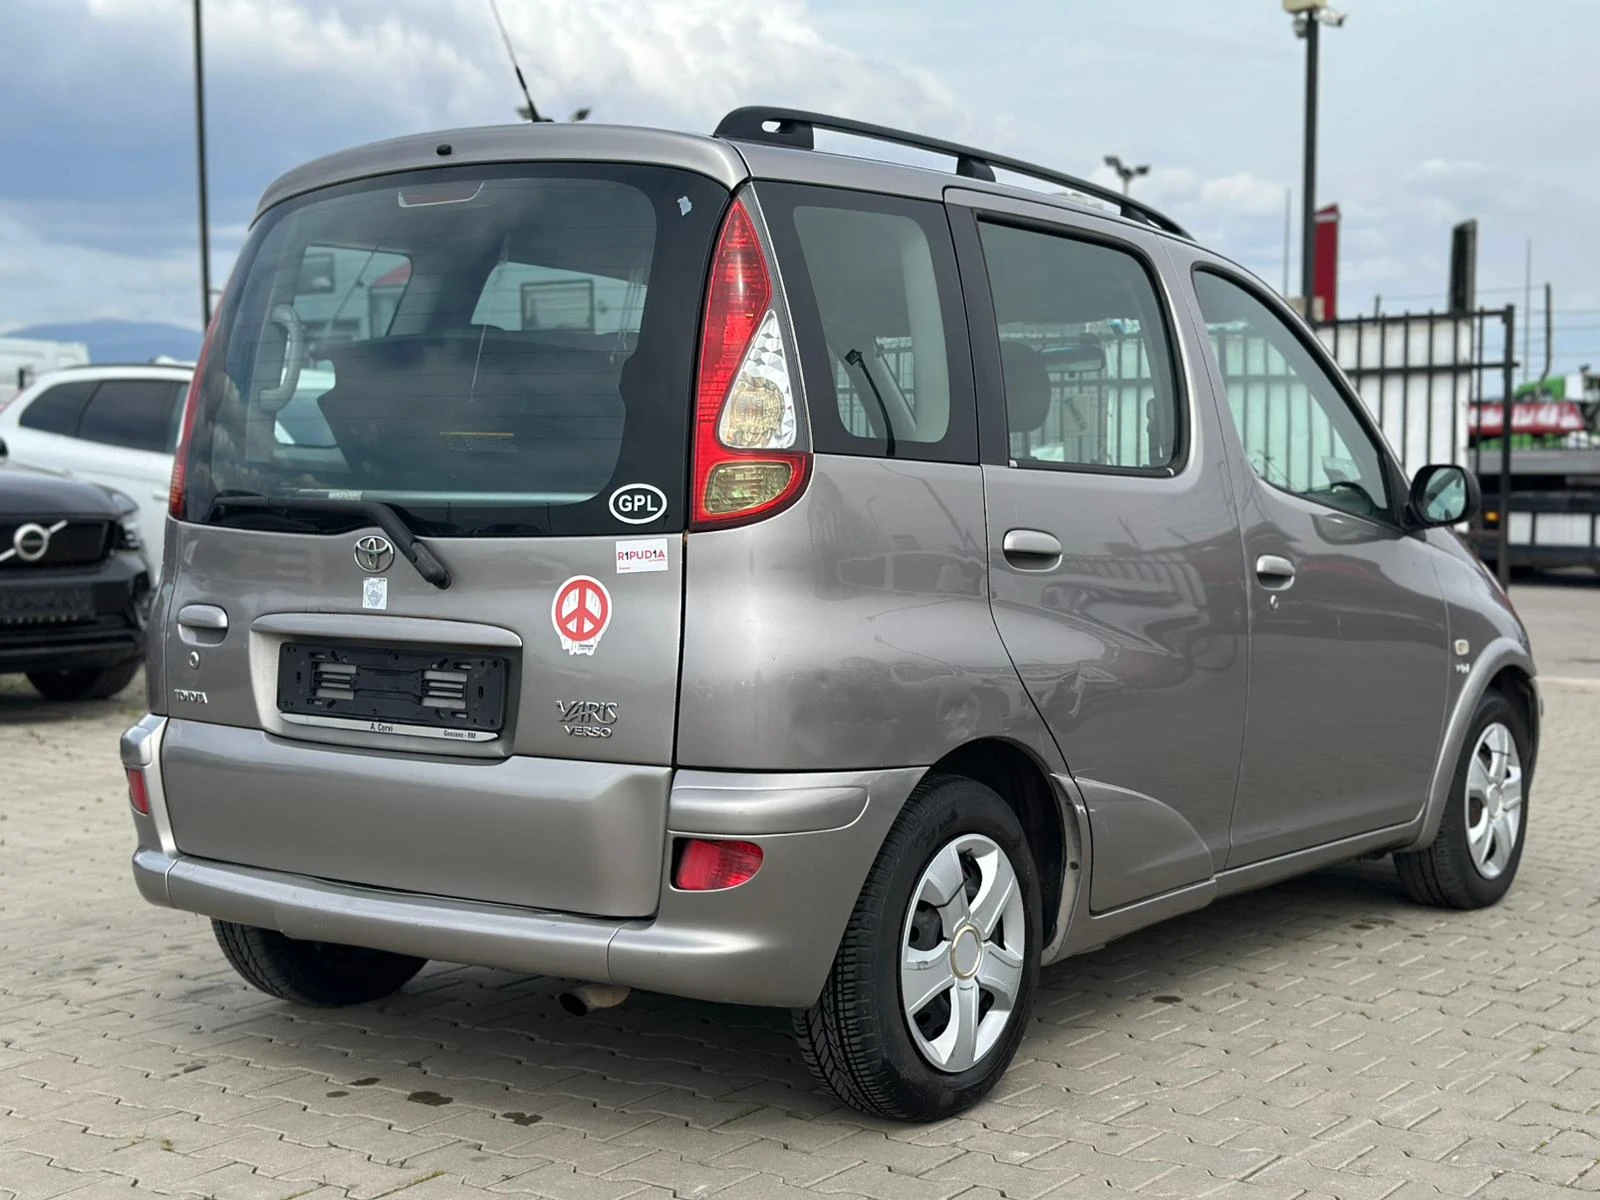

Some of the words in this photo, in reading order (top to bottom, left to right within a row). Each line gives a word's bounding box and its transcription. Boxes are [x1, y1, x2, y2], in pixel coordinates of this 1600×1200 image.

[618, 494, 659, 512] GPL
[617, 549, 666, 561] R1PUD1A
[563, 725, 613, 738] VERSO
